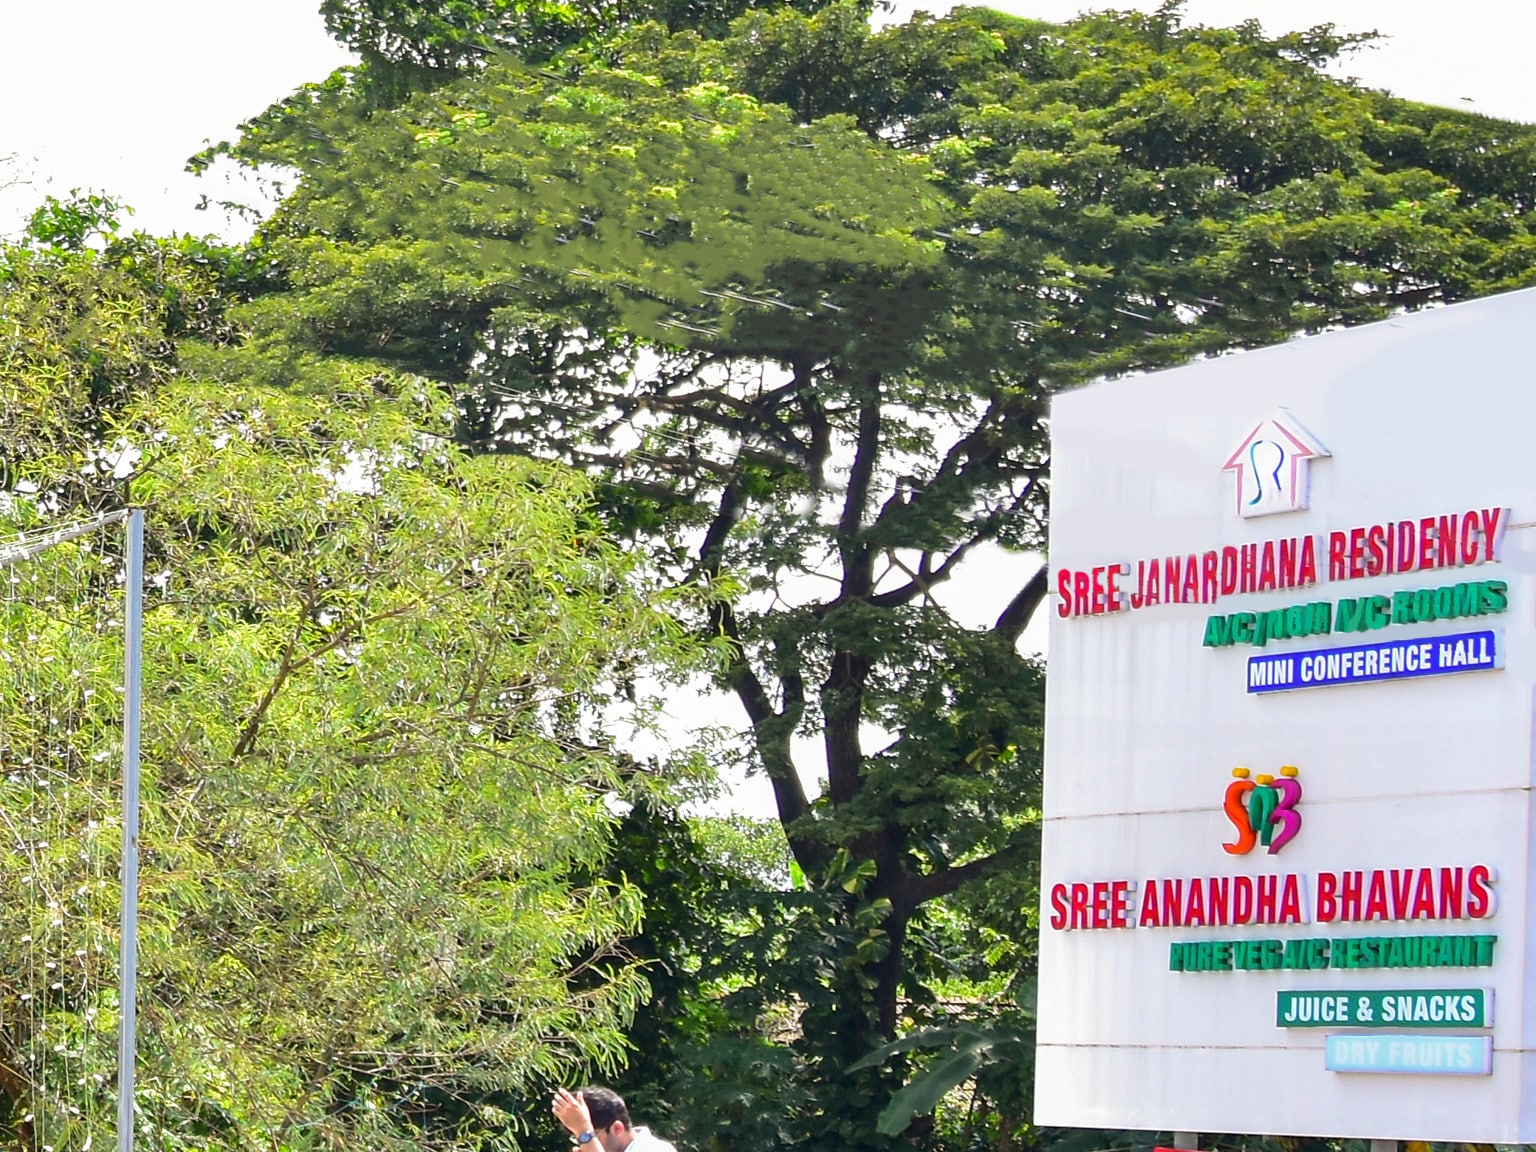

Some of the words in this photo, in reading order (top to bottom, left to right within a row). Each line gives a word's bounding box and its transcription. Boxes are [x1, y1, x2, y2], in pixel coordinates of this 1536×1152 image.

[1057, 563, 1128, 618] SREE
[1130, 534, 1317, 610] JANARDHANA
[1328, 506, 1504, 582] RESIDENCY
[1392, 580, 1509, 624] ROOMS
[1249, 659, 1294, 687] MINI
[1300, 644, 1431, 683] CONFERENCE
[1438, 636, 1492, 668] HALL
[1050, 880, 1134, 932] SREE
[1139, 873, 1304, 928] ANANDHA
[1316, 864, 1495, 924] BHAVANS
[1169, 941, 1232, 971] PURE
[1233, 939, 1283, 970] VEG
[1283, 937, 1330, 969] A/C
[1331, 934, 1498, 968] RESTAURANT
[1284, 996, 1348, 1022] JUICE
[1356, 996, 1373, 1022] &
[1381, 995, 1476, 1022] SNACKS
[1334, 1041, 1380, 1066] DRY
[1388, 1040, 1473, 1068] FRUITS
